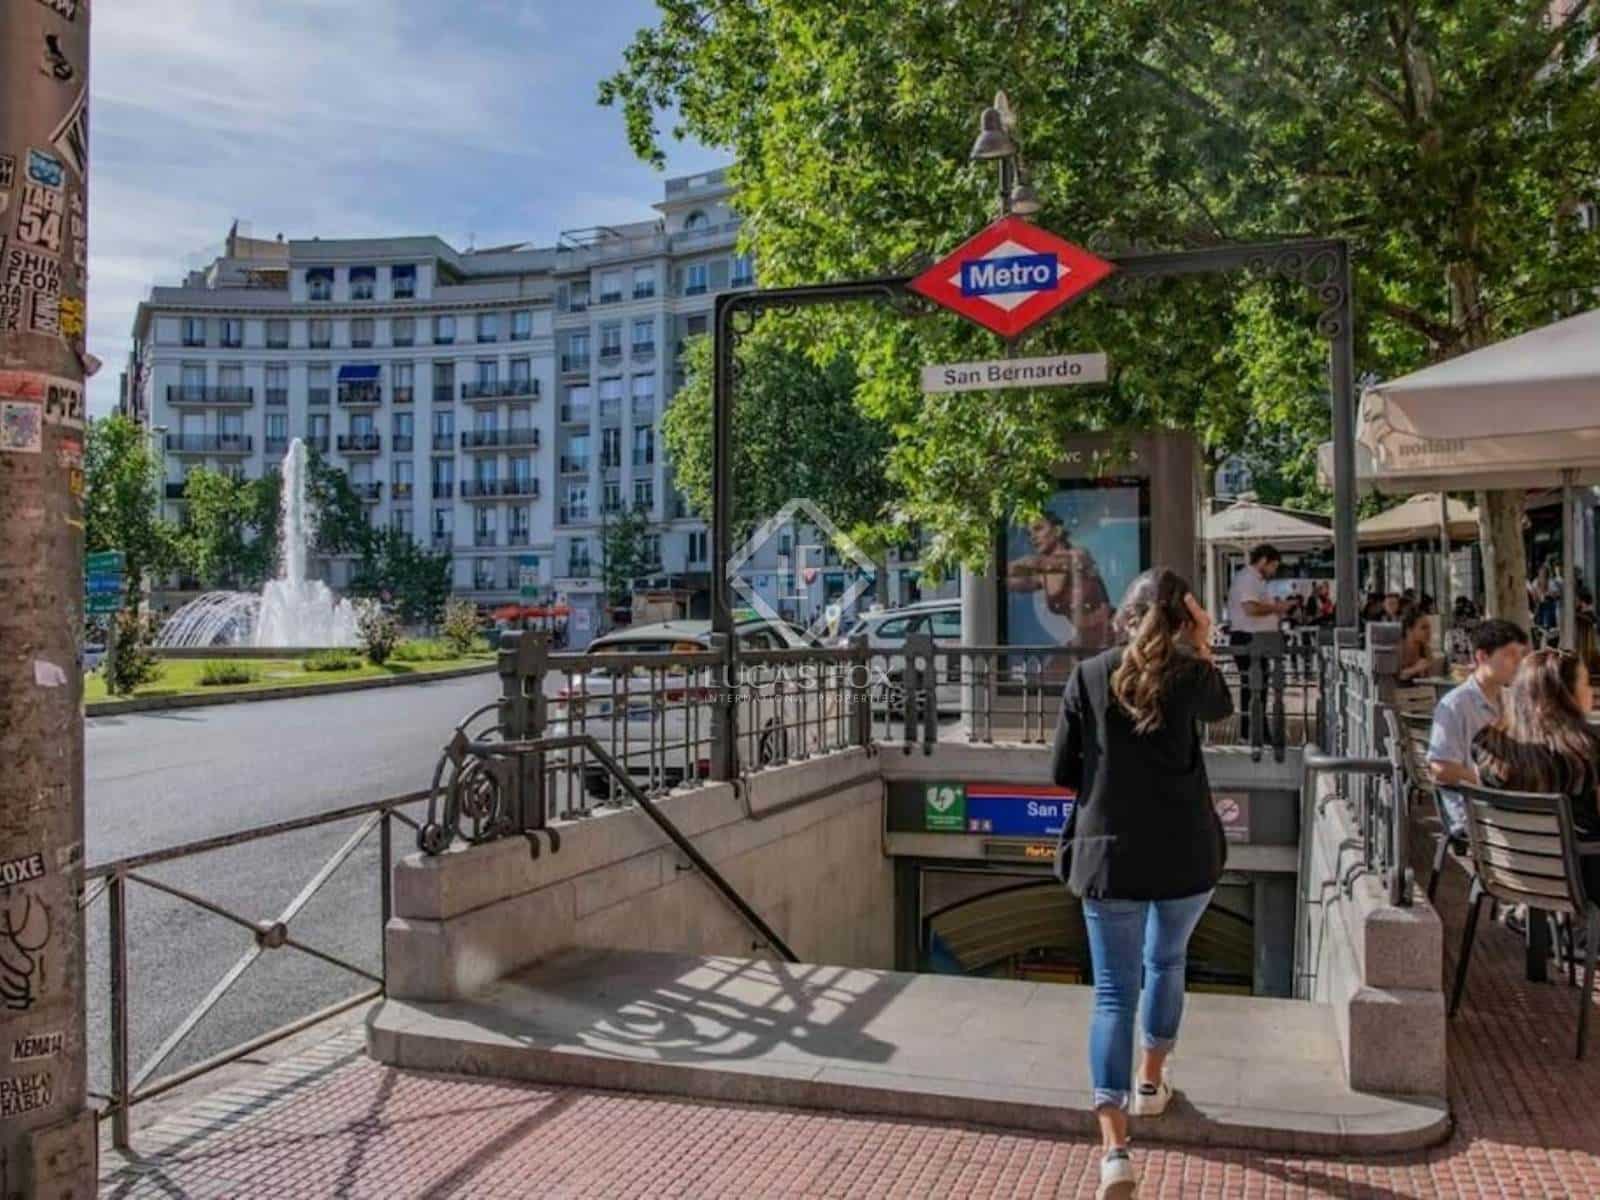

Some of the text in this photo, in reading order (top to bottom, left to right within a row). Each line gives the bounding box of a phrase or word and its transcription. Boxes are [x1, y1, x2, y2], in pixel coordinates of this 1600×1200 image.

[17, 204, 61, 251] 54
[7, 267, 60, 295] FEOR
[969, 262, 1050, 289] Metro
[943, 360, 1082, 386] San Bernardo
[1027, 802, 1058, 818] San
